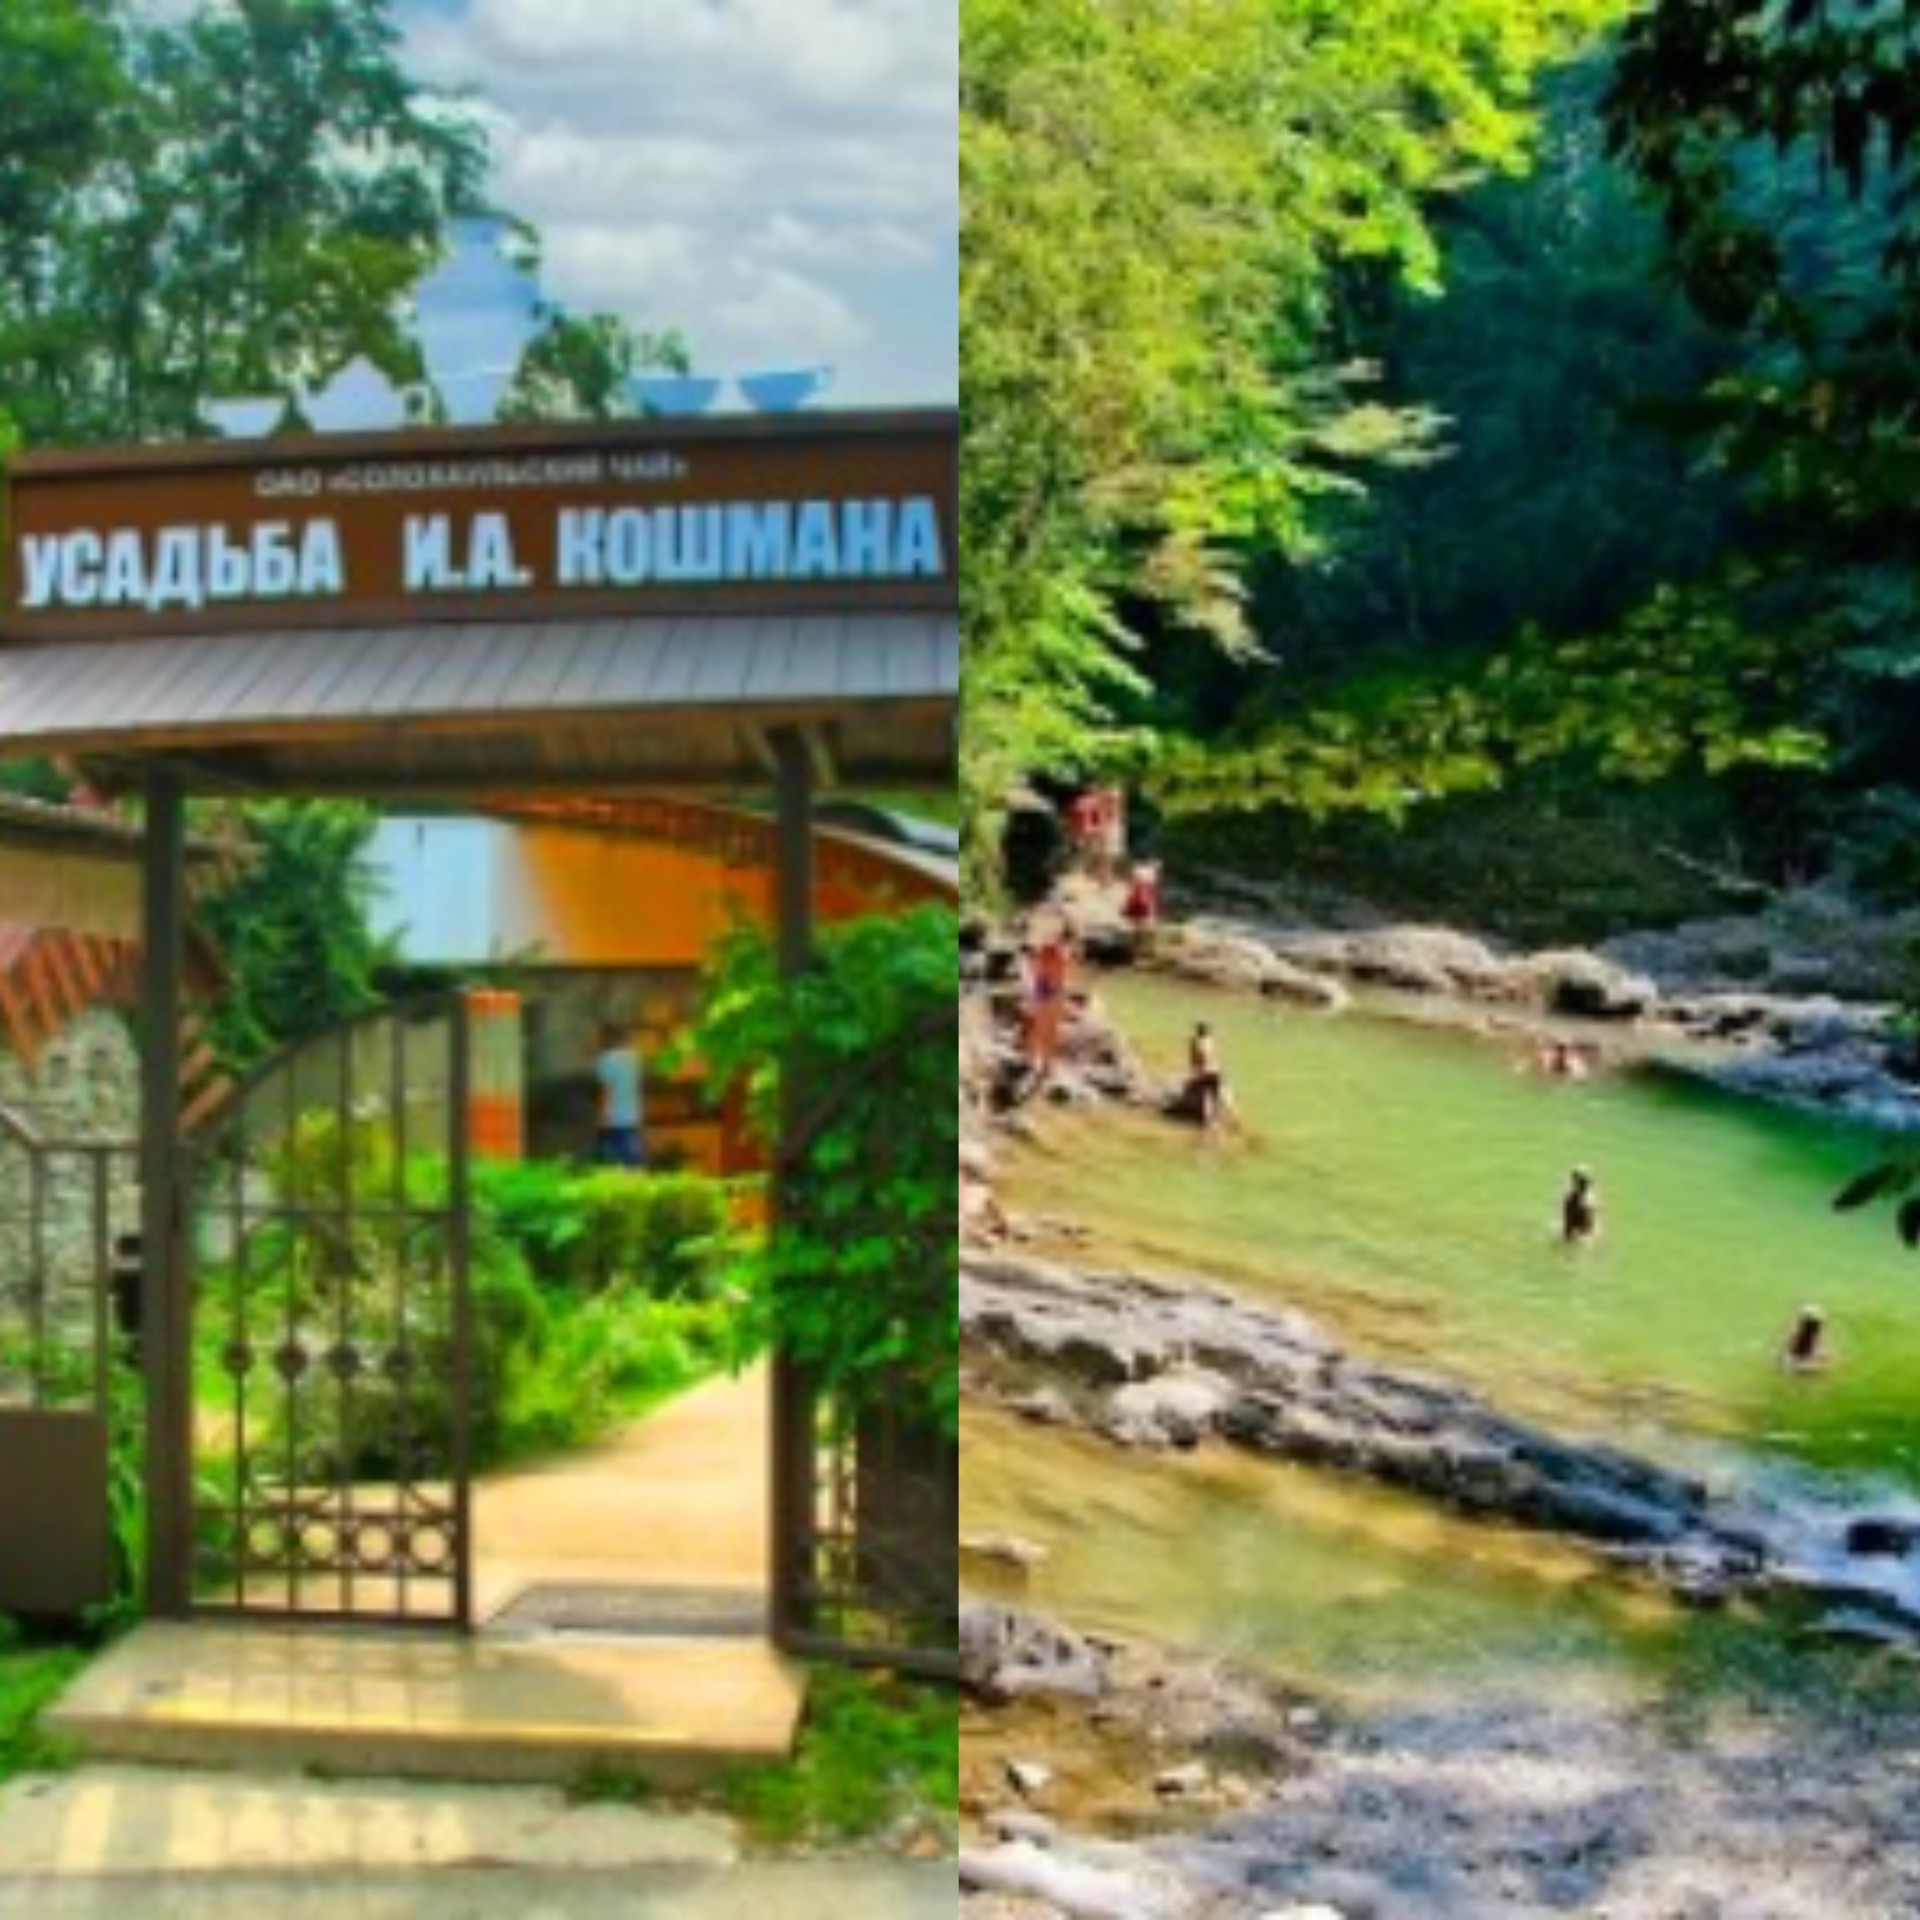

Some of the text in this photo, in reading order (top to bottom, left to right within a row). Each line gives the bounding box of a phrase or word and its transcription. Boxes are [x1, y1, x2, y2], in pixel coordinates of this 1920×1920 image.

[255, 467, 322, 496] ОАО
[20, 495, 945, 611] УСАДЬБА И.А. КОШМАНА
